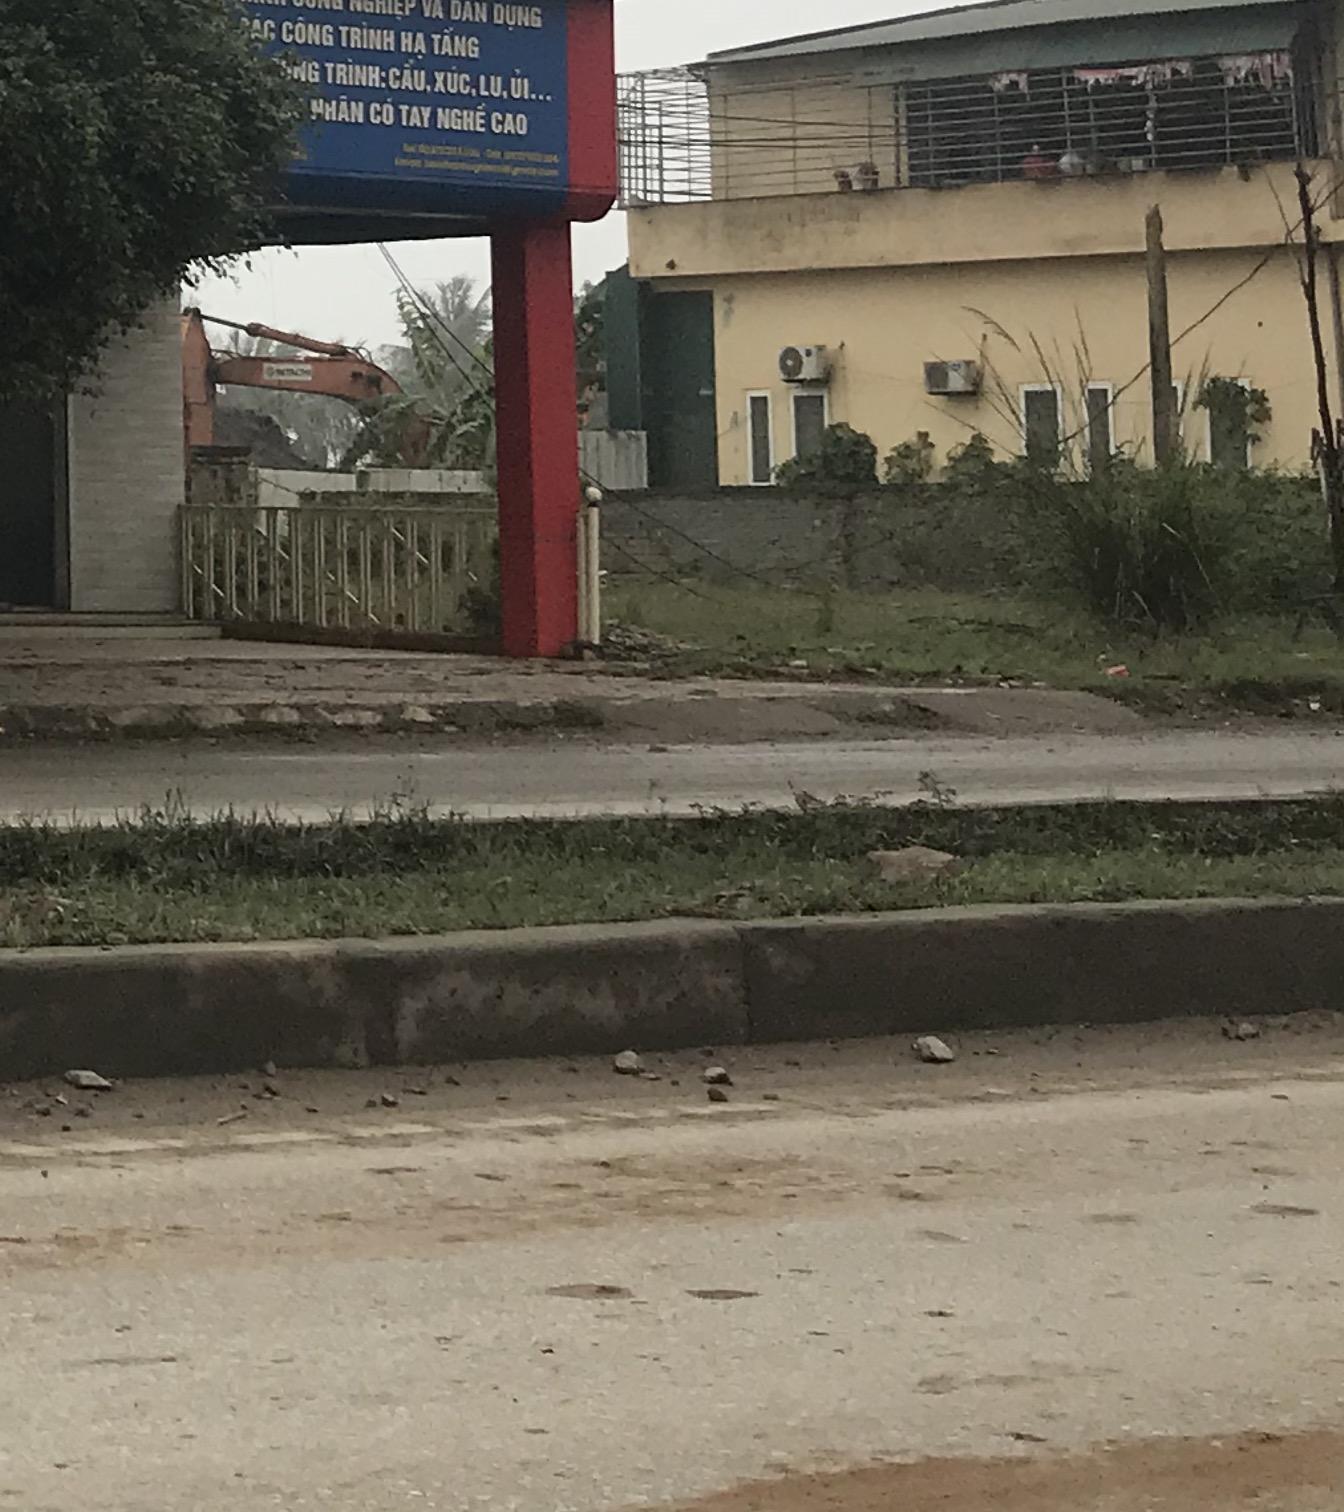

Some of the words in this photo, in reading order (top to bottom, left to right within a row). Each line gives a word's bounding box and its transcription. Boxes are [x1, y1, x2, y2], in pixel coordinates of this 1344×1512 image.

[493, 3, 543, 31] DỤNG
[282, 15, 334, 47] CÔNG
[339, 21, 395, 52] TRÌNH
[400, 31, 427, 60] HẠ
[431, 26, 480, 59] TẦNG
[434, 65, 477, 97] XÚC,
[479, 74, 508, 99] LU,
[370, 97, 394, 126] CÓ
[398, 103, 433, 129] TAY
[437, 102, 486, 133] NGHỀ
[490, 111, 528, 135] CAO
